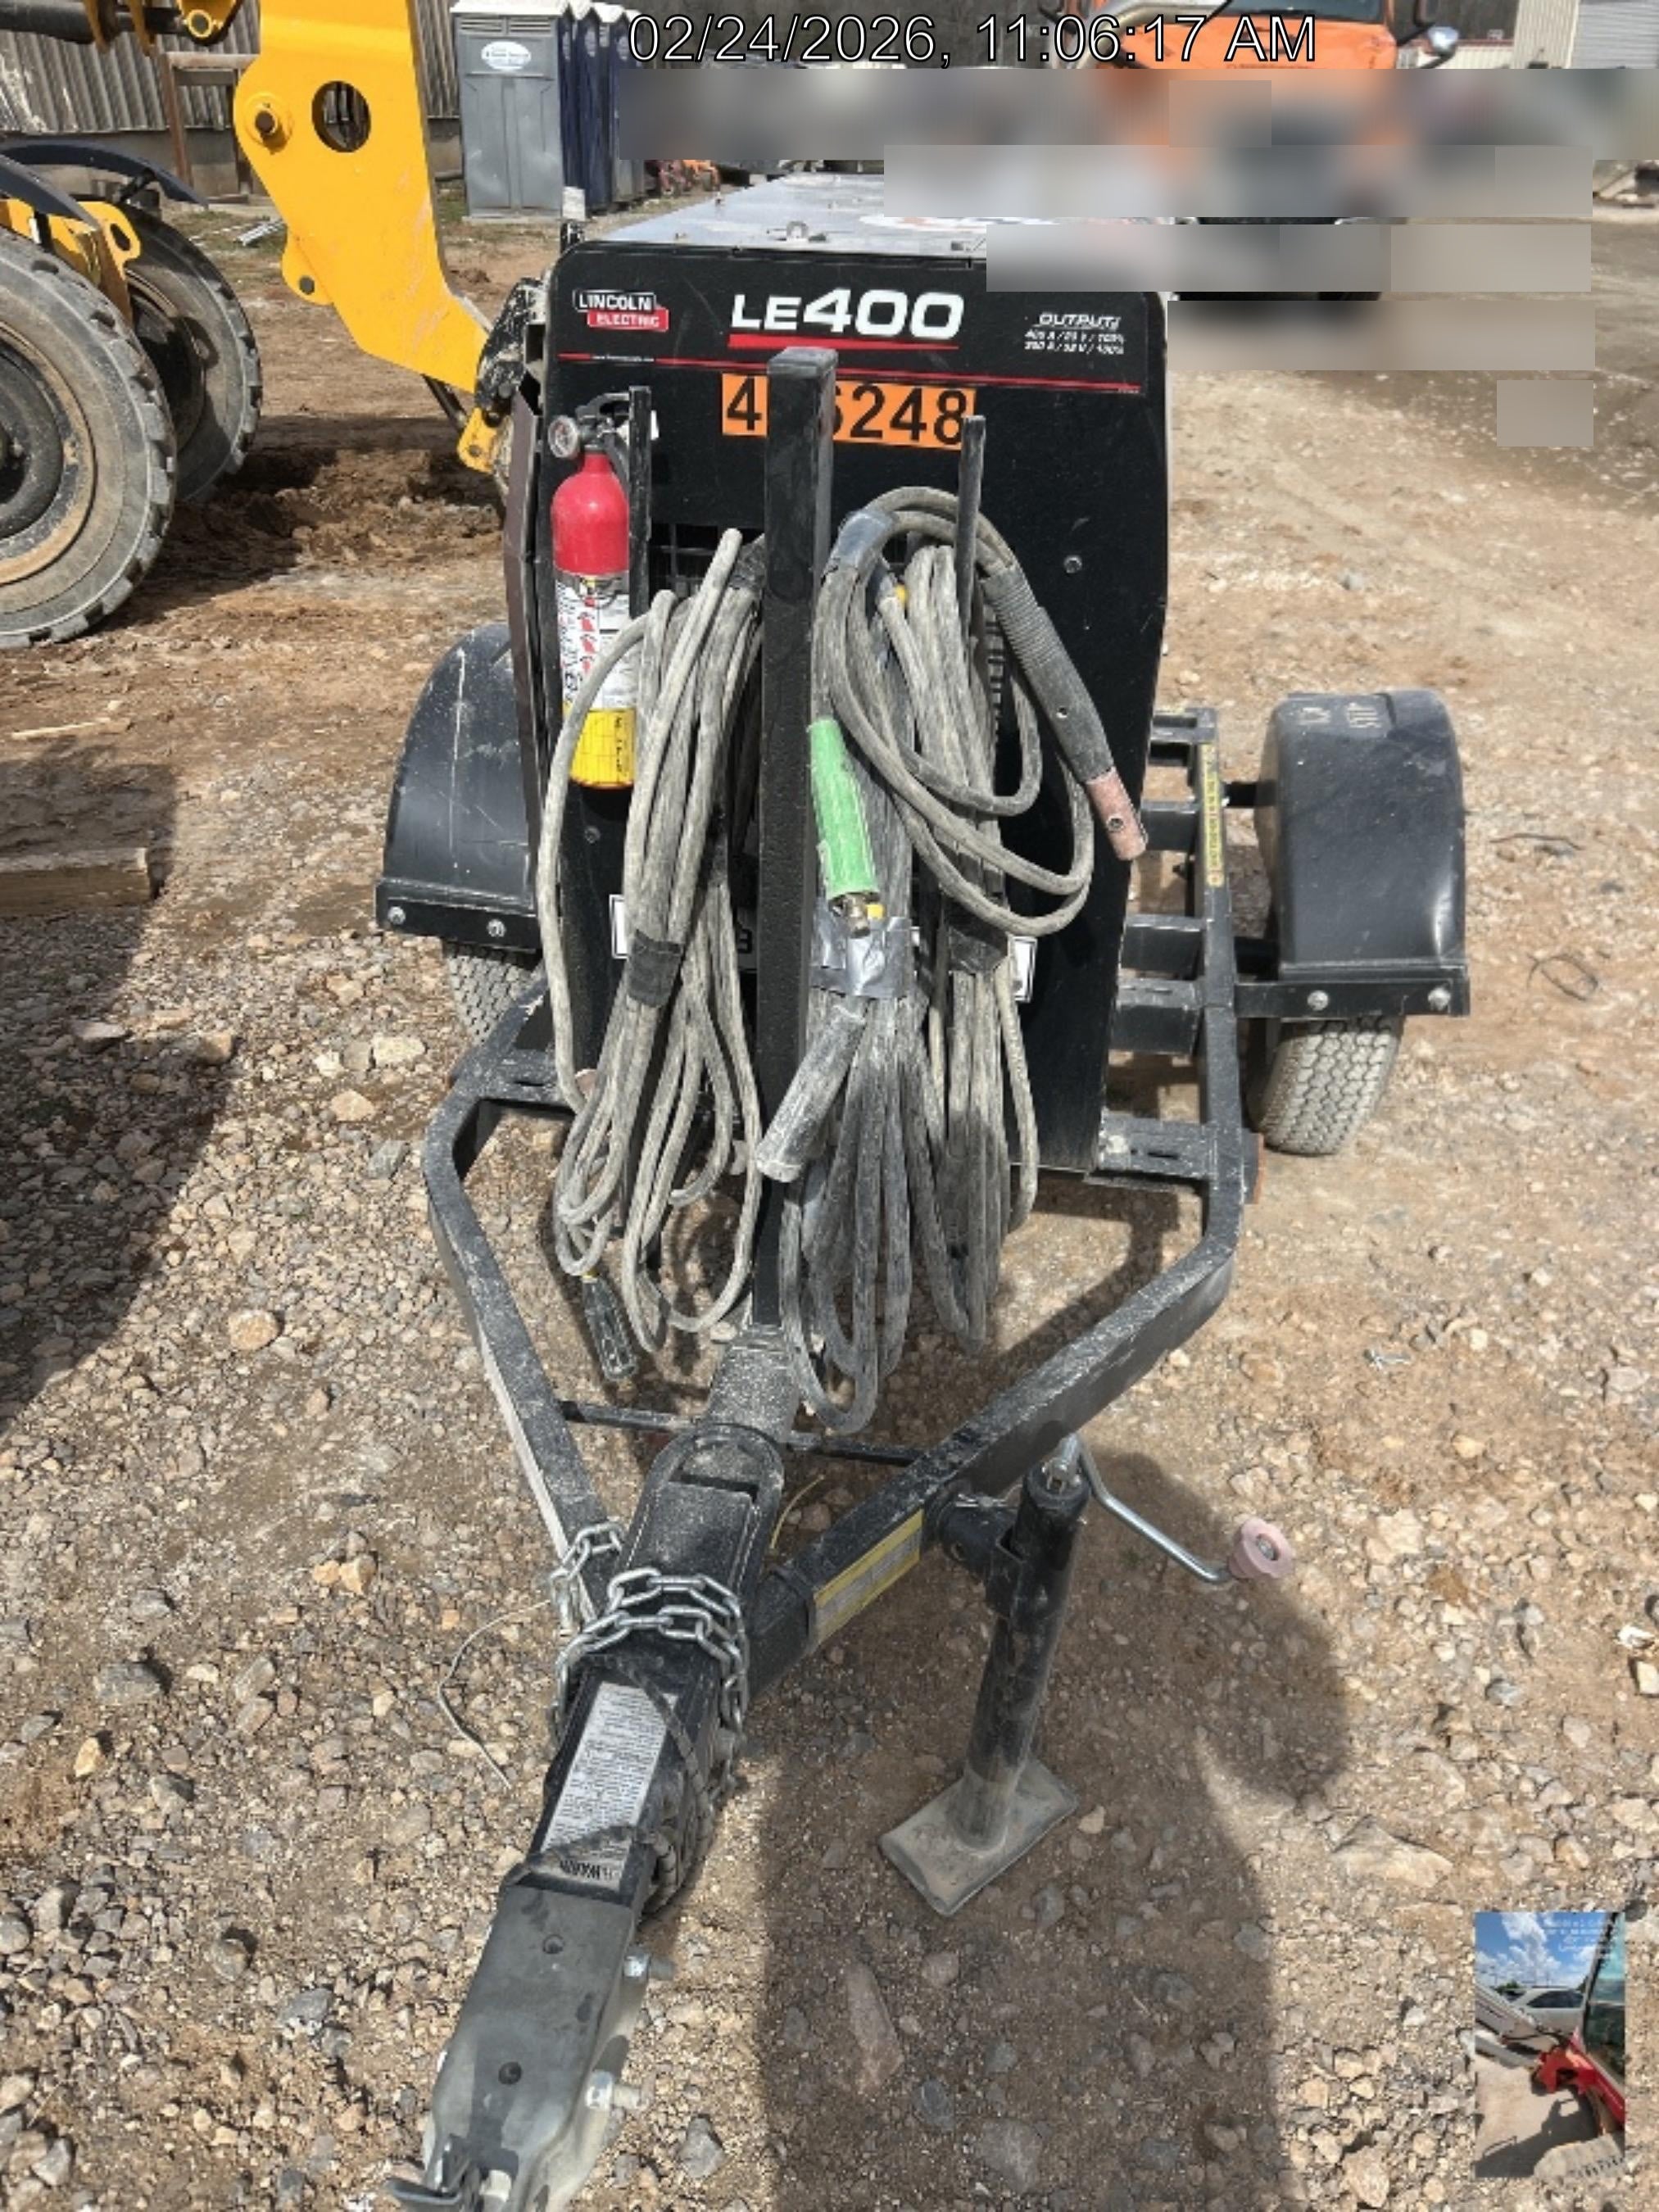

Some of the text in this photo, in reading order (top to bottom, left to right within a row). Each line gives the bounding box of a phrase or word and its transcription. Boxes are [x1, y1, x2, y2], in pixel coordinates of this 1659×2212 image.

[579, 294, 652, 310] LINCOLN
[596, 312, 660, 328] ELECTRIC
[731, 288, 964, 339] LE400
